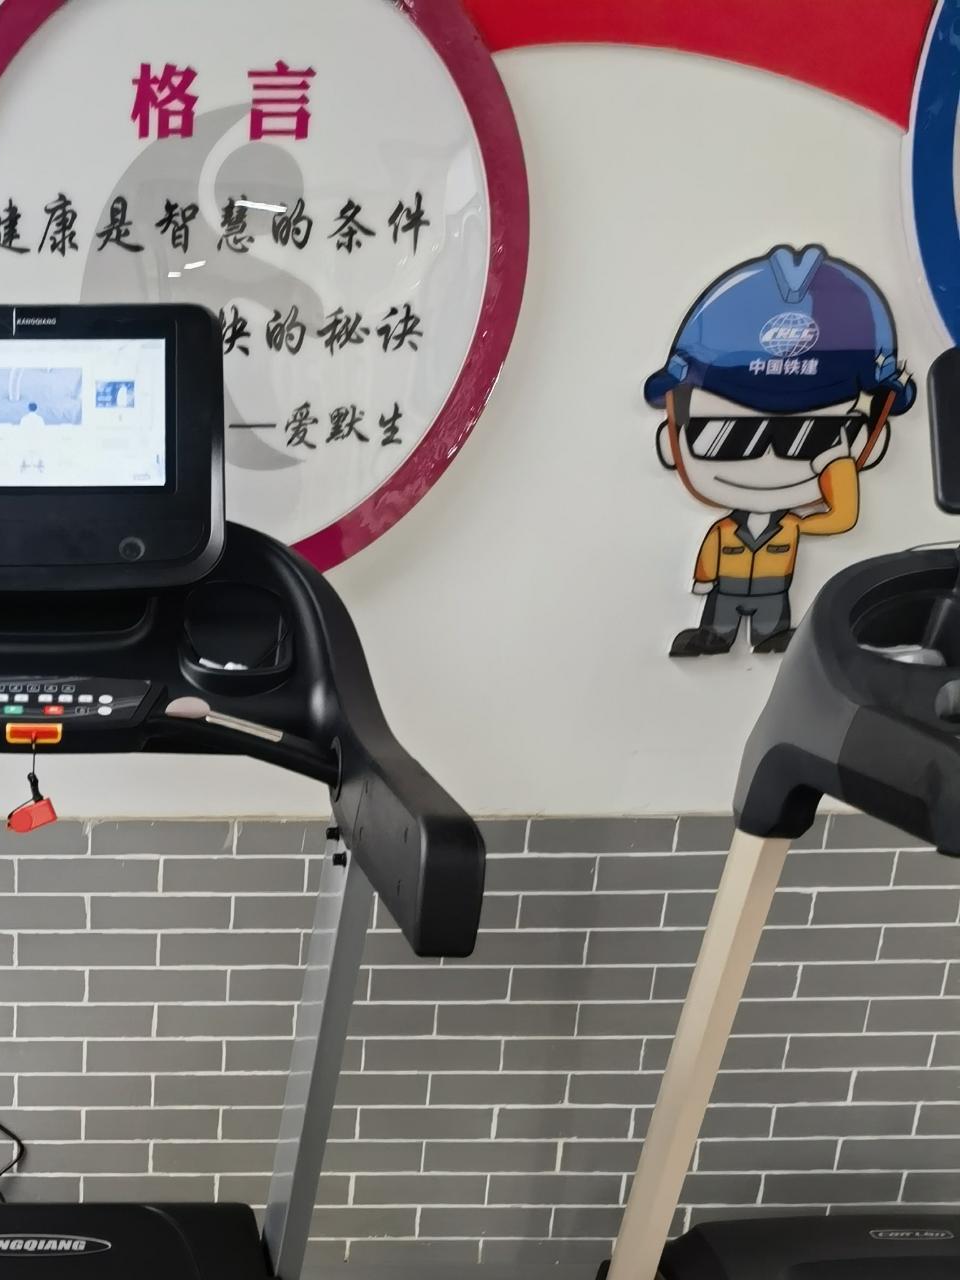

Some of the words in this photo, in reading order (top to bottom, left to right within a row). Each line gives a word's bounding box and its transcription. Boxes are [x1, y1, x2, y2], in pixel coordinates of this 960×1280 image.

[131, 60, 317, 141] 格言
[748, 358, 819, 376] 中国铁建
